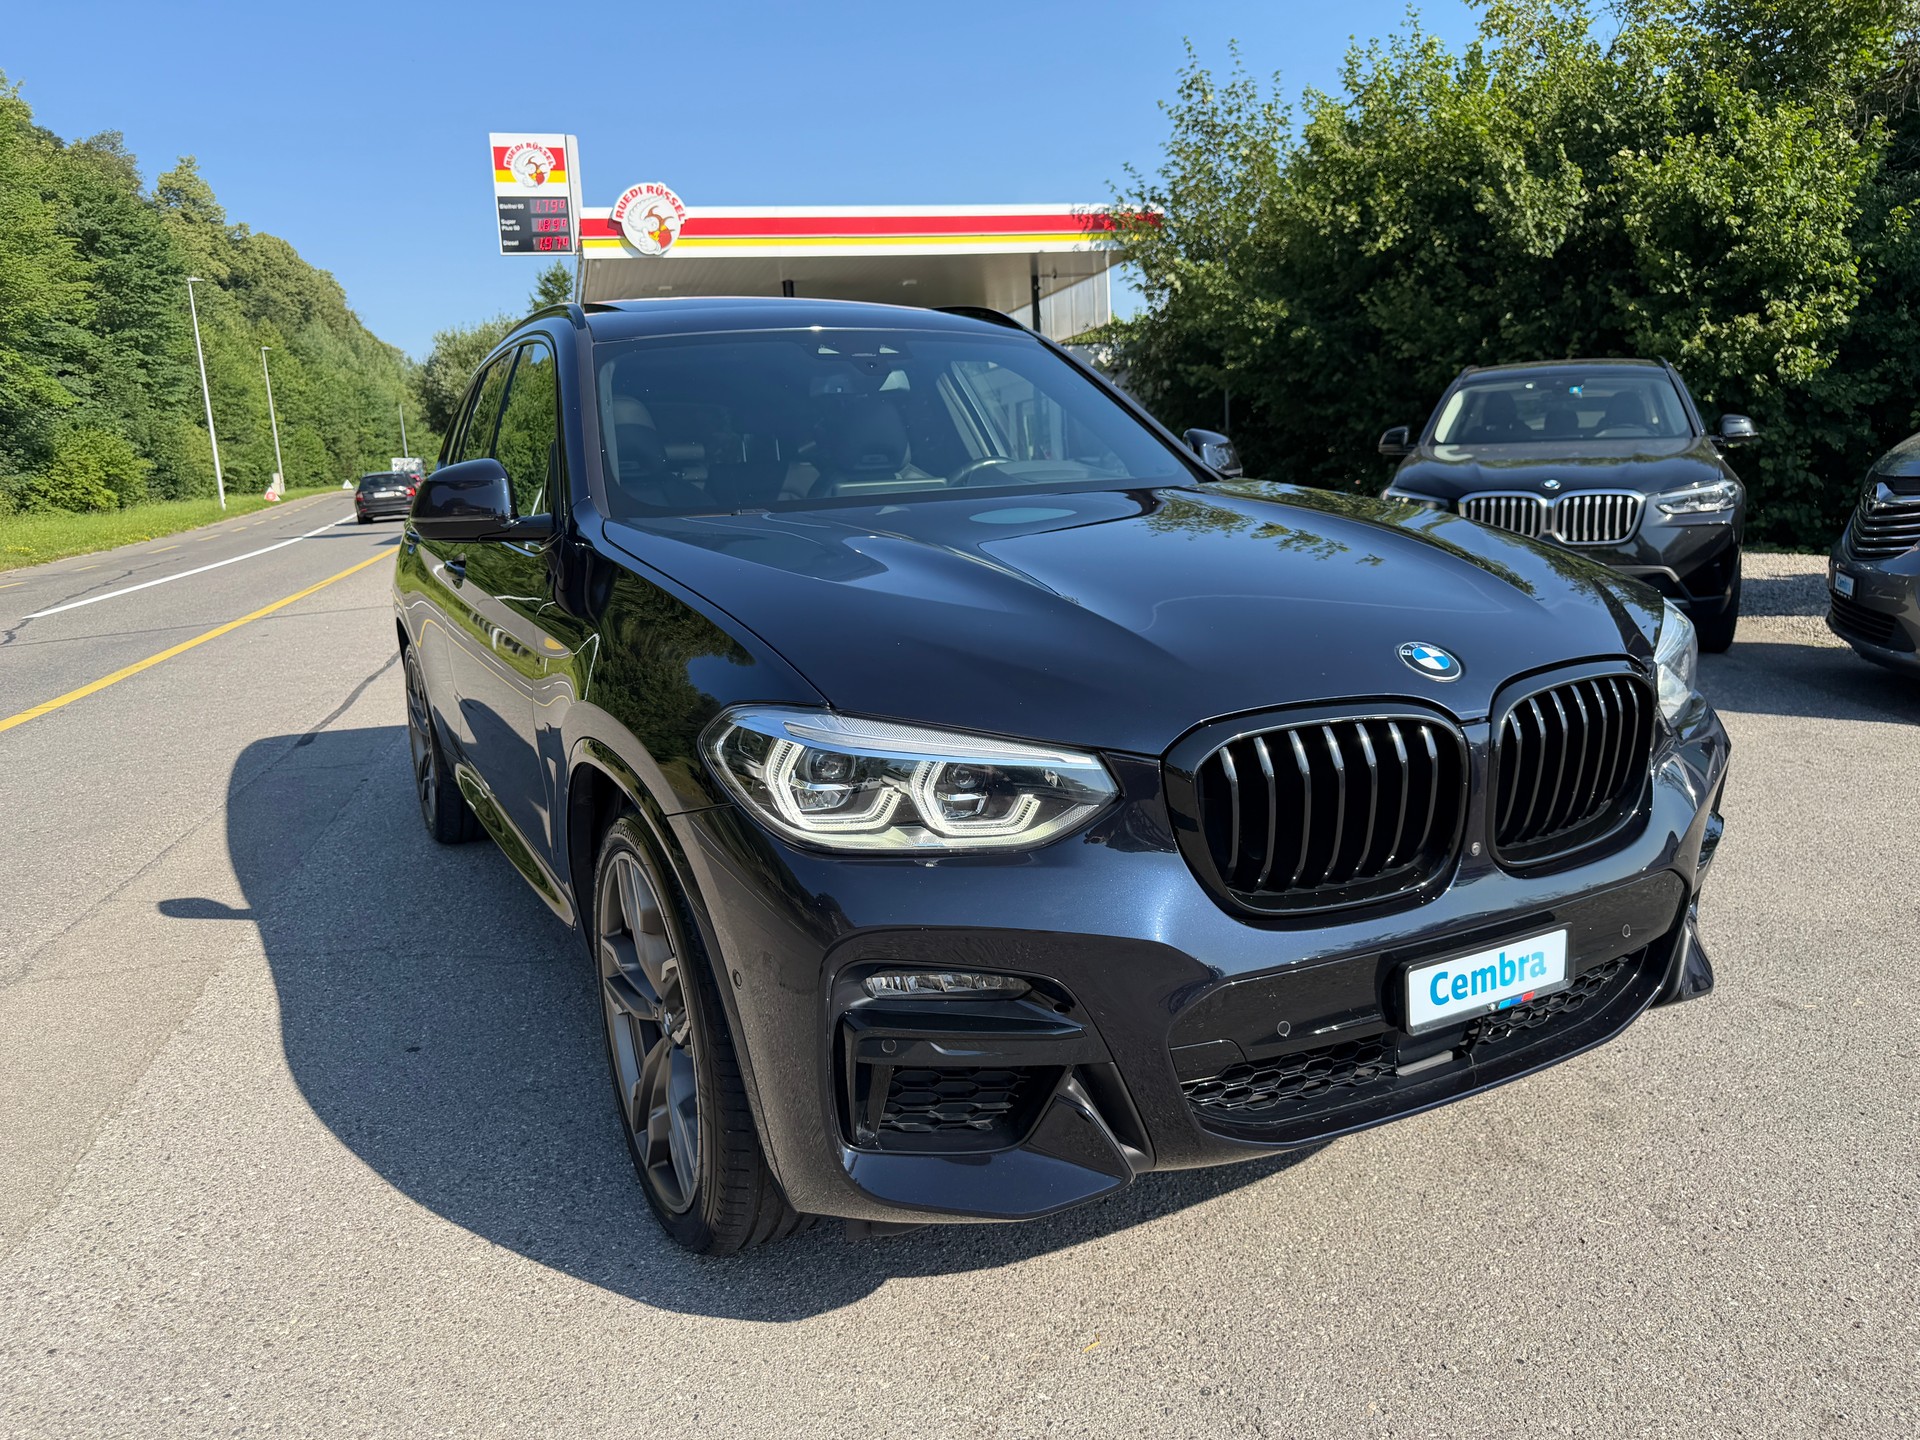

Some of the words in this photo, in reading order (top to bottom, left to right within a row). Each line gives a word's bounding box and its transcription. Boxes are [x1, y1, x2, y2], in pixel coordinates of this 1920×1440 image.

[506, 143, 524, 166] RUEDI
[526, 141, 554, 167] RÜSSEL
[615, 186, 643, 219] RUEDI
[646, 184, 687, 221] RÜSSEL
[1430, 951, 1547, 1006] Cembra
